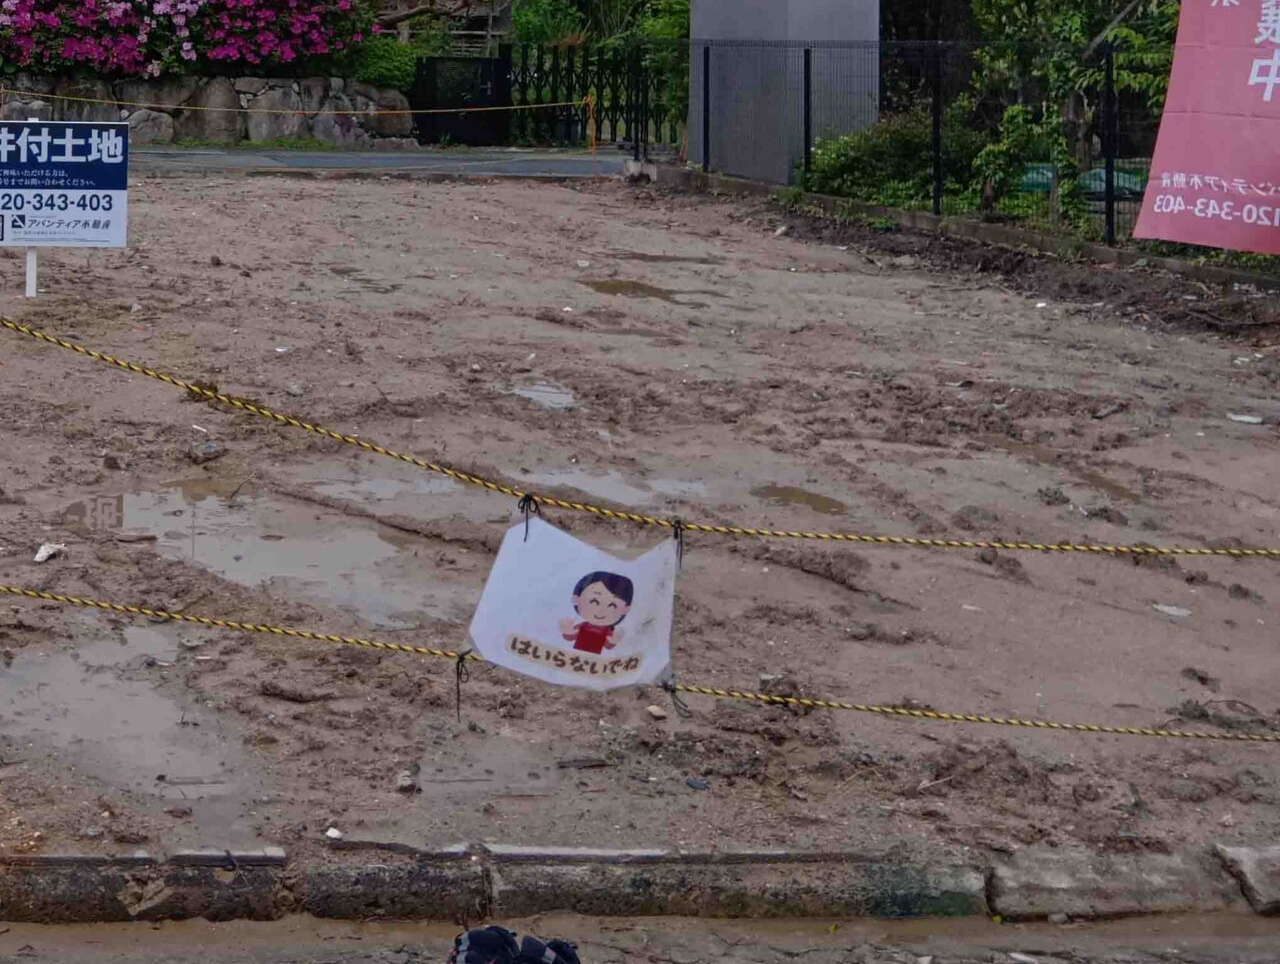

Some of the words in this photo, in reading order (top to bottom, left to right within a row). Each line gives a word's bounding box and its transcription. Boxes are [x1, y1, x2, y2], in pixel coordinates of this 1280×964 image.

[510, 635, 640, 675] はいらないでね
